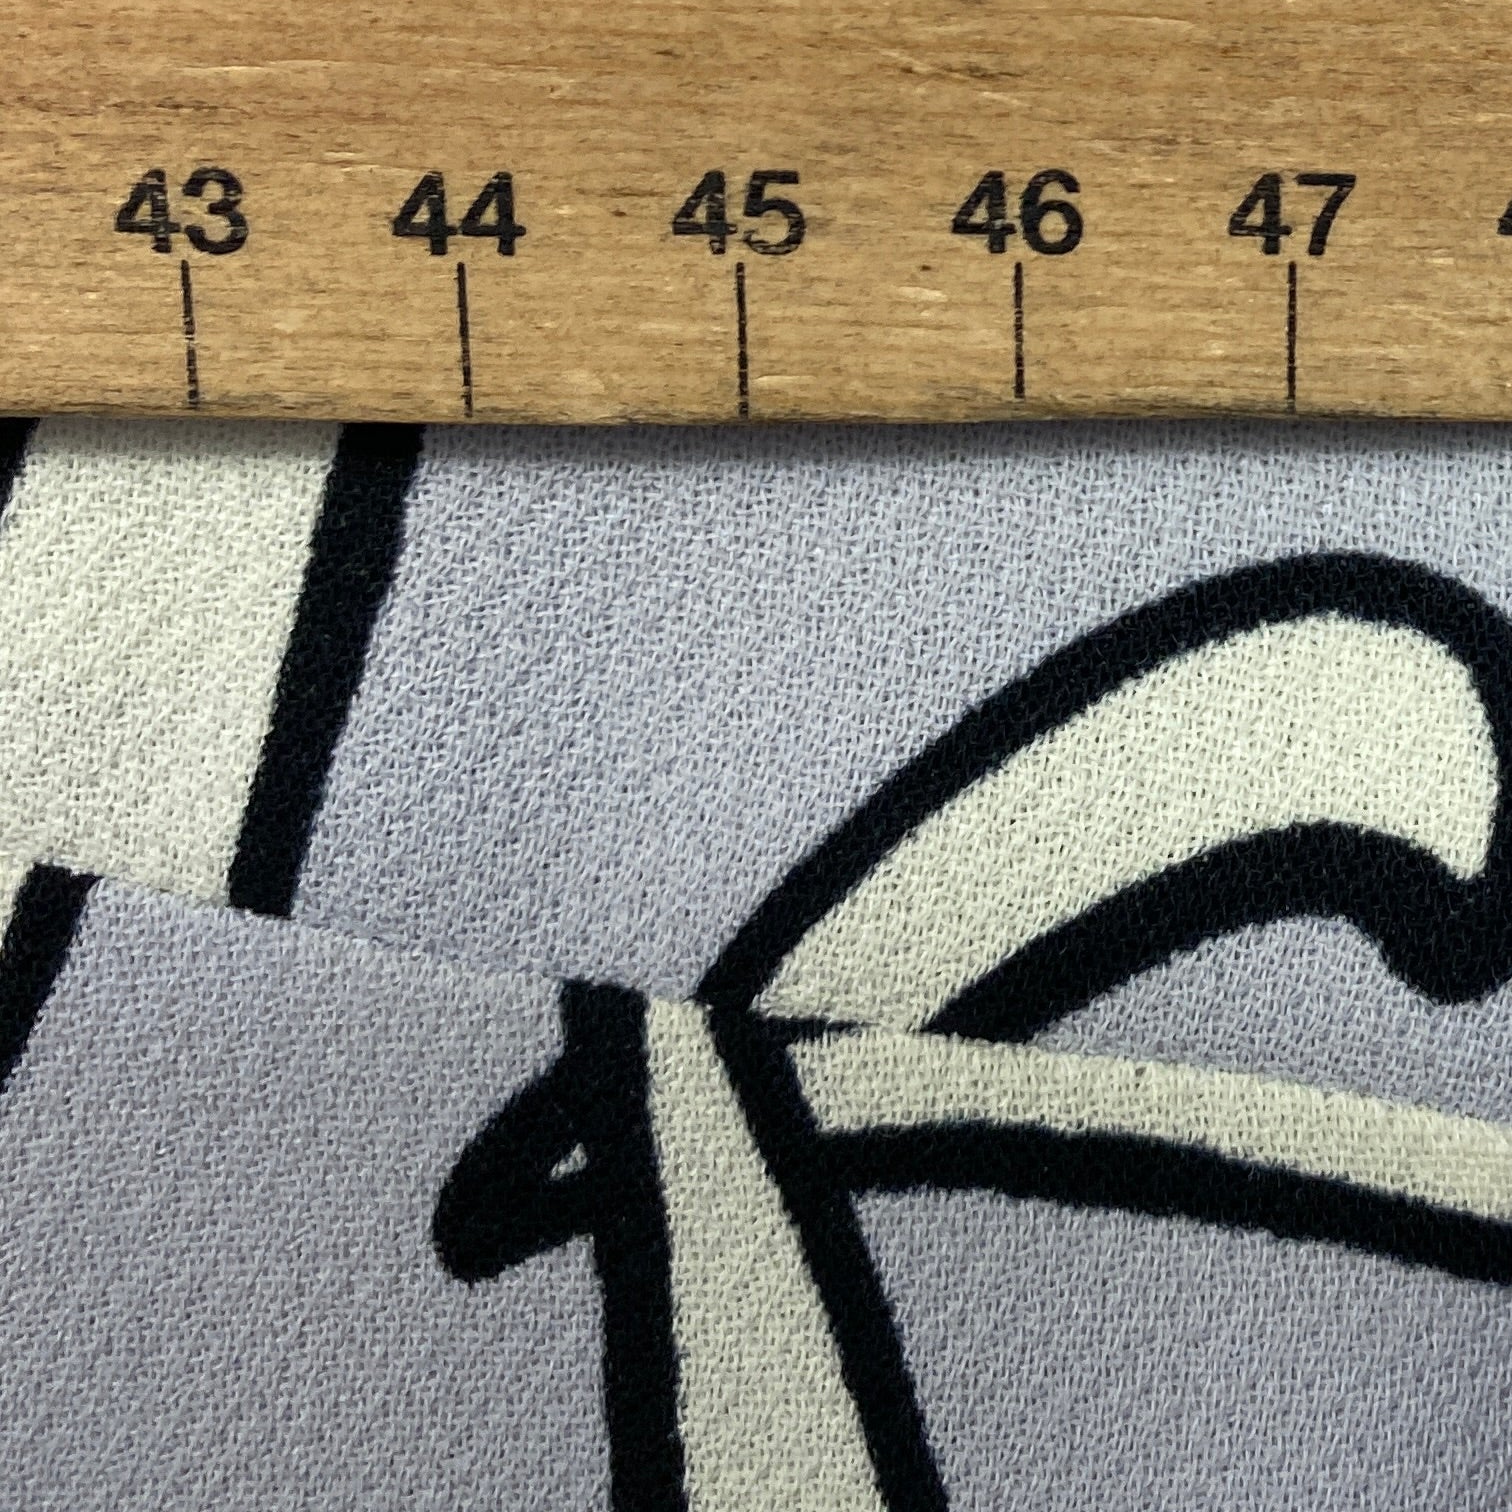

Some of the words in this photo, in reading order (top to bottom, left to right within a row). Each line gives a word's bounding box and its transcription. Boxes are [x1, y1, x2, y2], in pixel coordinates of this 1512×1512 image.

[114, 167, 248, 255] 43
[390, 171, 526, 256] 44
[672, 169, 806, 256] 45
[951, 169, 1084, 255] 46
[1227, 173, 1356, 257] 47
